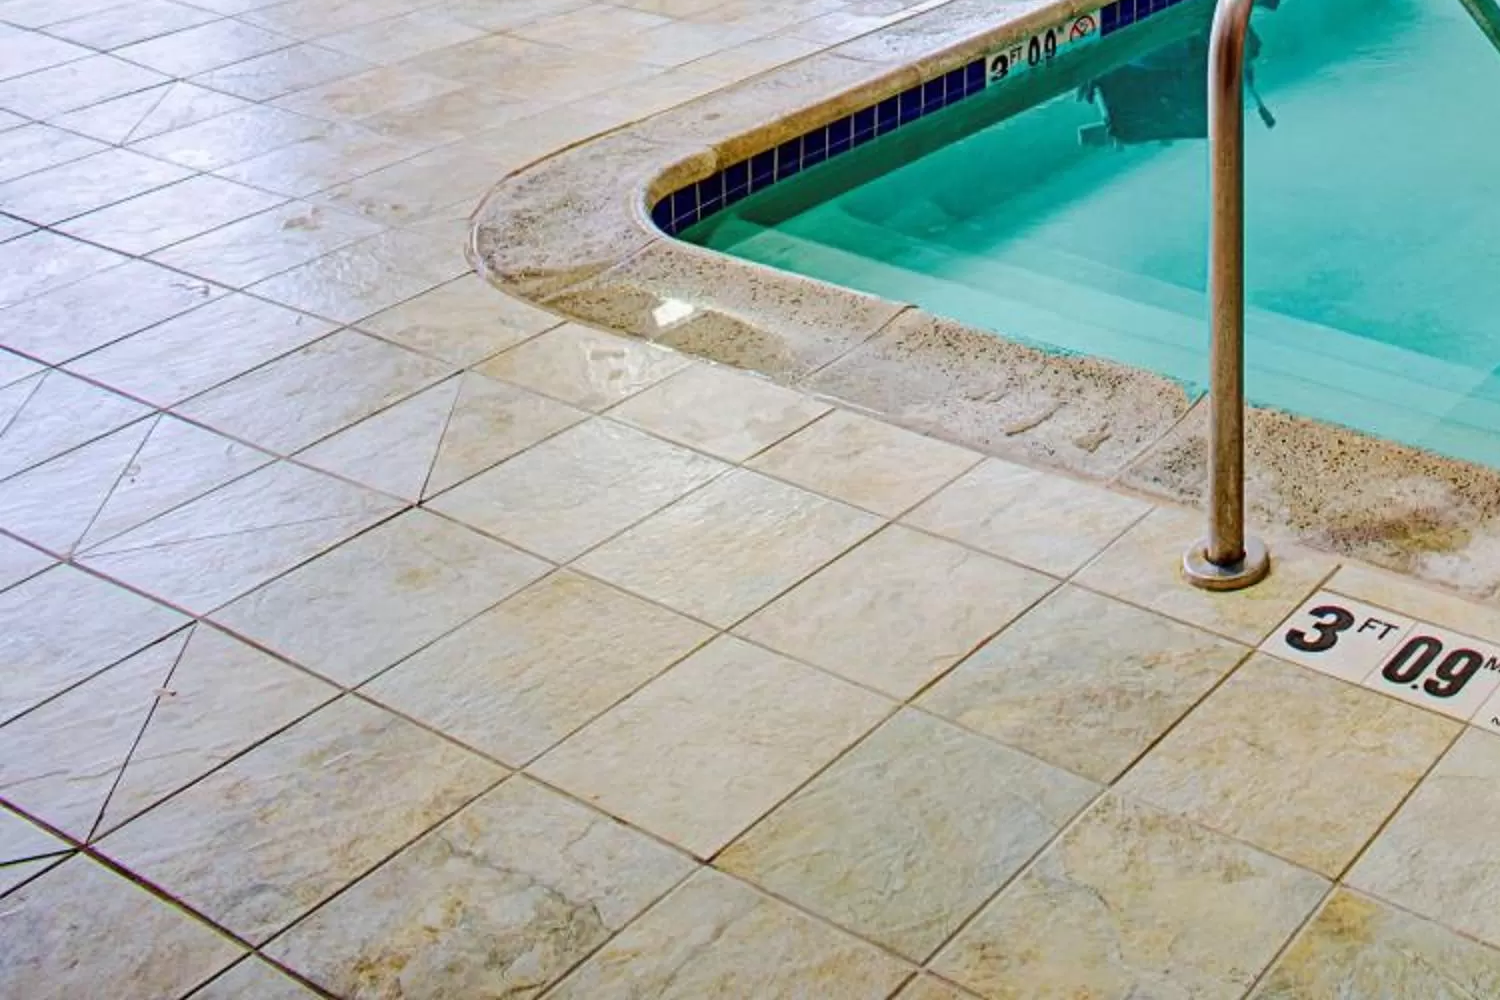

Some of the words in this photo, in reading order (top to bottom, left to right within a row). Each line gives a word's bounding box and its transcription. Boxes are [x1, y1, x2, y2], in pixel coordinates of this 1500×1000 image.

[1285, 605, 1355, 653] 3
[1357, 617, 1400, 641] FT
[1381, 634, 1485, 699] 0.9
